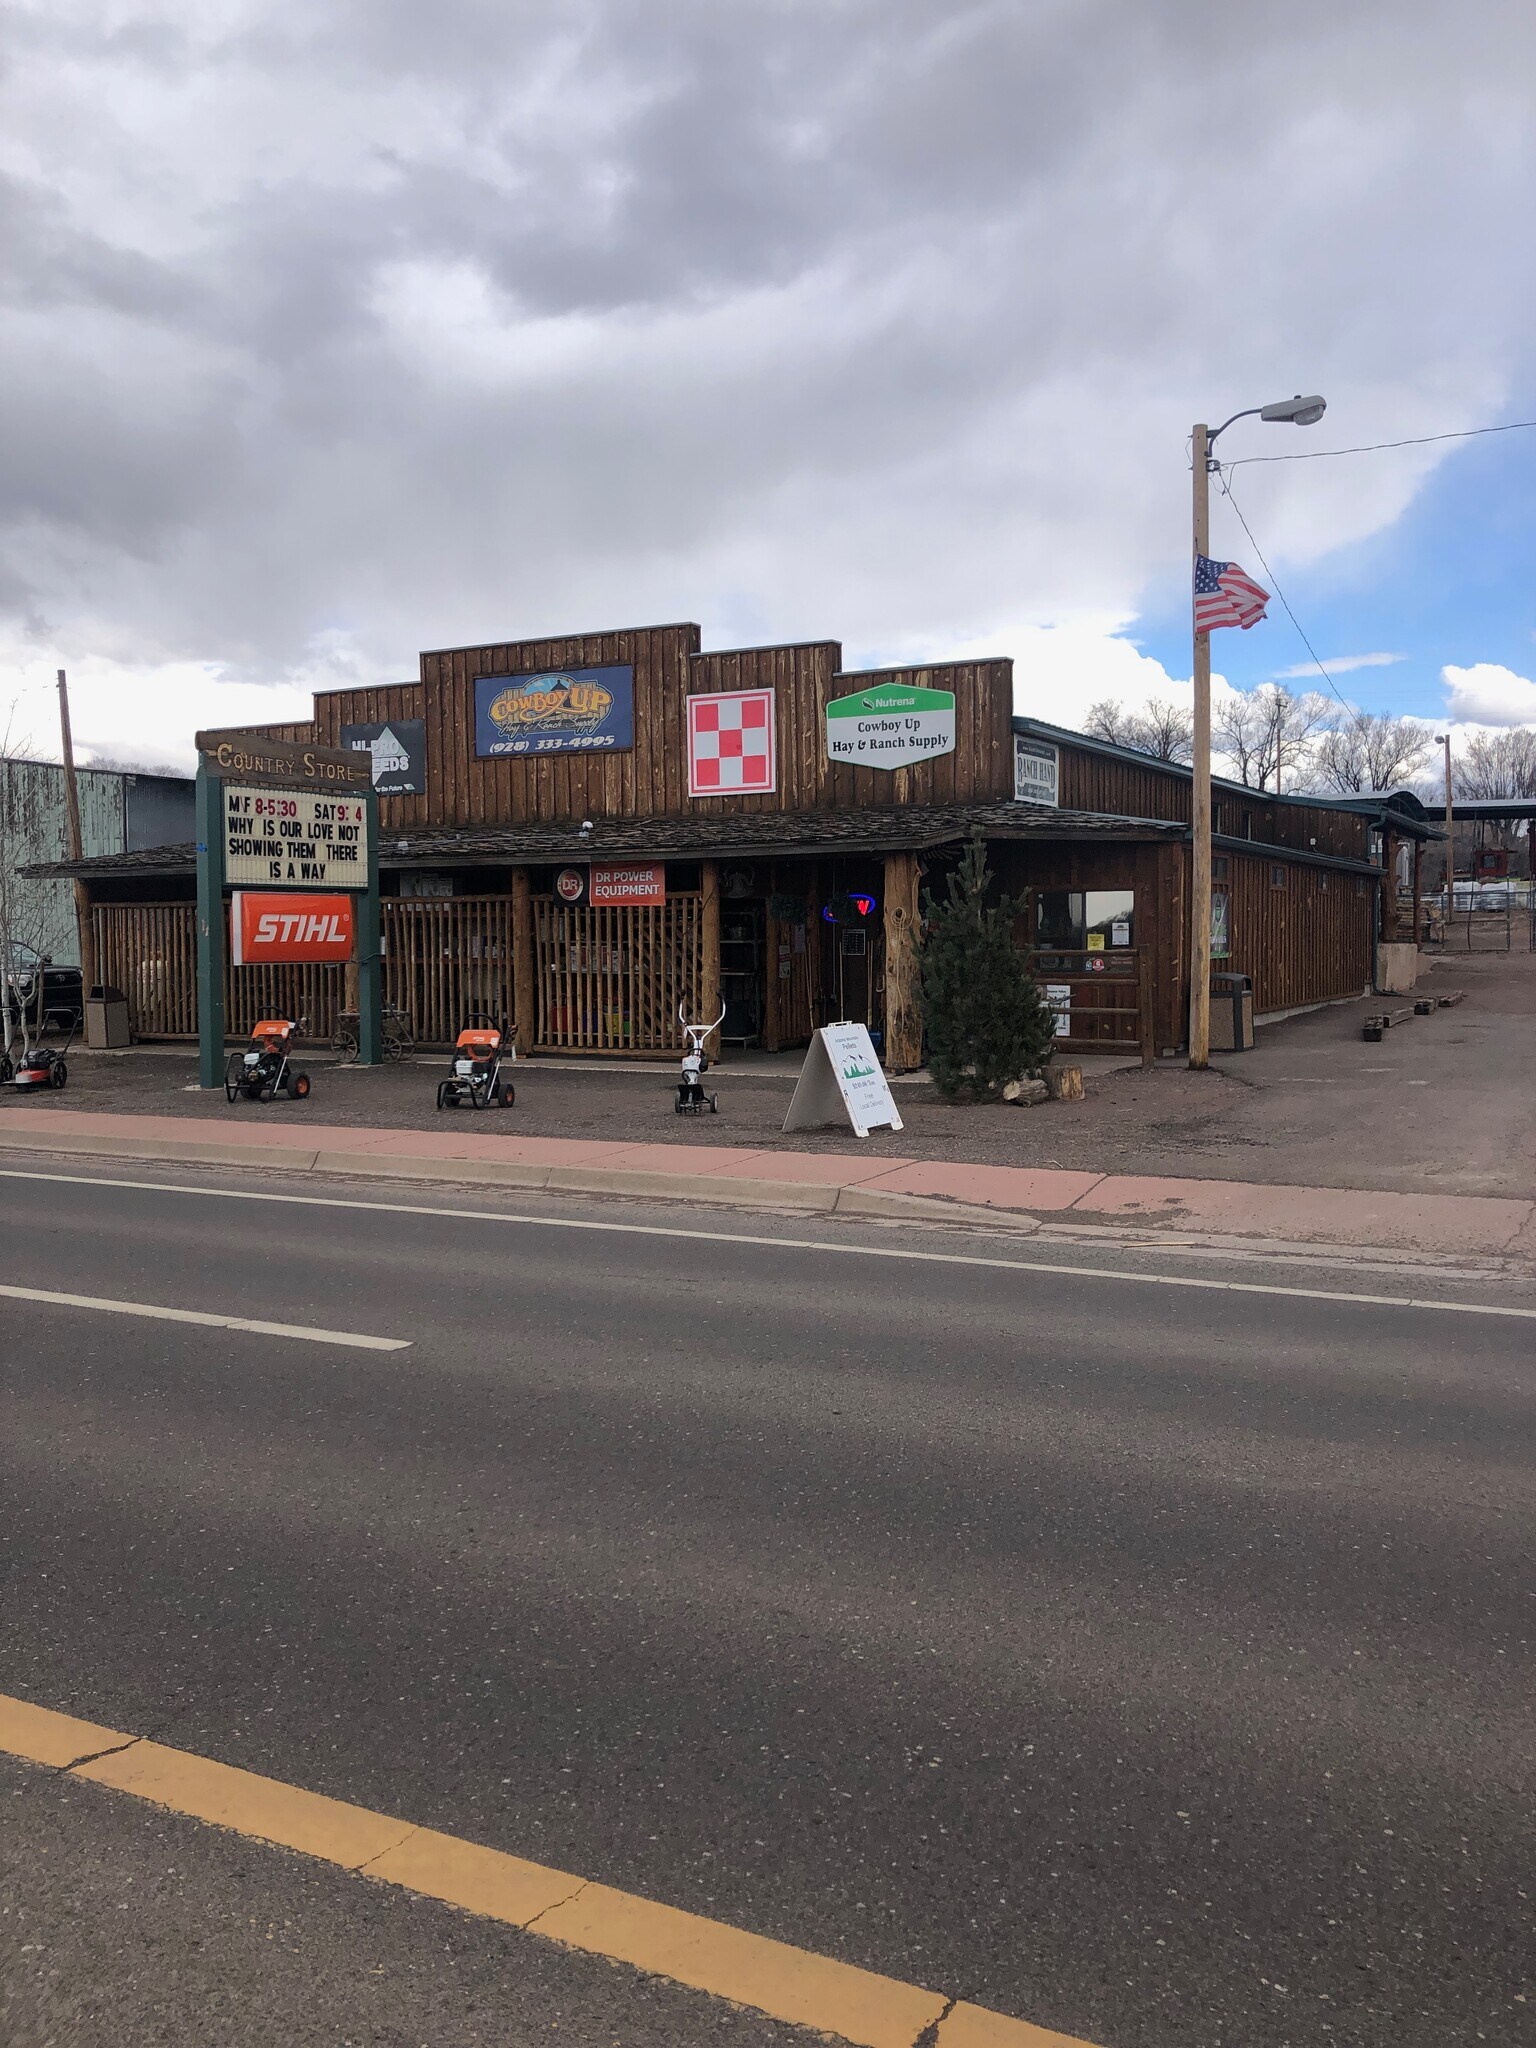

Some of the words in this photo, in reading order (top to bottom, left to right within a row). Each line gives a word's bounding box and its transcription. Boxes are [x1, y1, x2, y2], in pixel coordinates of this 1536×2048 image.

[569, 687, 612, 713] UP
[875, 697, 915, 708] Nutrena
[502, 722, 520, 736] Hay
[534, 718, 562, 730] Ranch
[568, 717, 600, 733] Supply
[858, 720, 901, 733] Cowboy
[905, 719, 920, 732] Up
[489, 740, 530, 753] (928)
[535, 735, 615, 750] 333-4995
[833, 741, 854, 754] Hay
[858, 740, 866, 750] &
[870, 737, 905, 750] Ranch
[909, 734, 949, 749] Supply
[372, 756, 409, 773] EEDS
[255, 798, 297, 817] 8-5:30
[228, 817, 254, 835] WHY
[263, 820, 275, 836] IS
[280, 821, 302, 838] OUR
[308, 823, 333, 840] LOVE
[338, 825, 360, 841] NOT
[229, 838, 283, 857] SHOWING
[287, 842, 316, 859] THEM
[326, 844, 358, 861] THERE
[269, 861, 281, 878] IS
[287, 863, 295, 879] A
[301, 863, 326, 880] WAY
[595, 872, 611, 883] DR
[614, 871, 654, 882] POWER
[562, 879, 578, 891] DR
[595, 885, 660, 898] EQUIPMENT
[254, 914, 346, 942] STIHL
